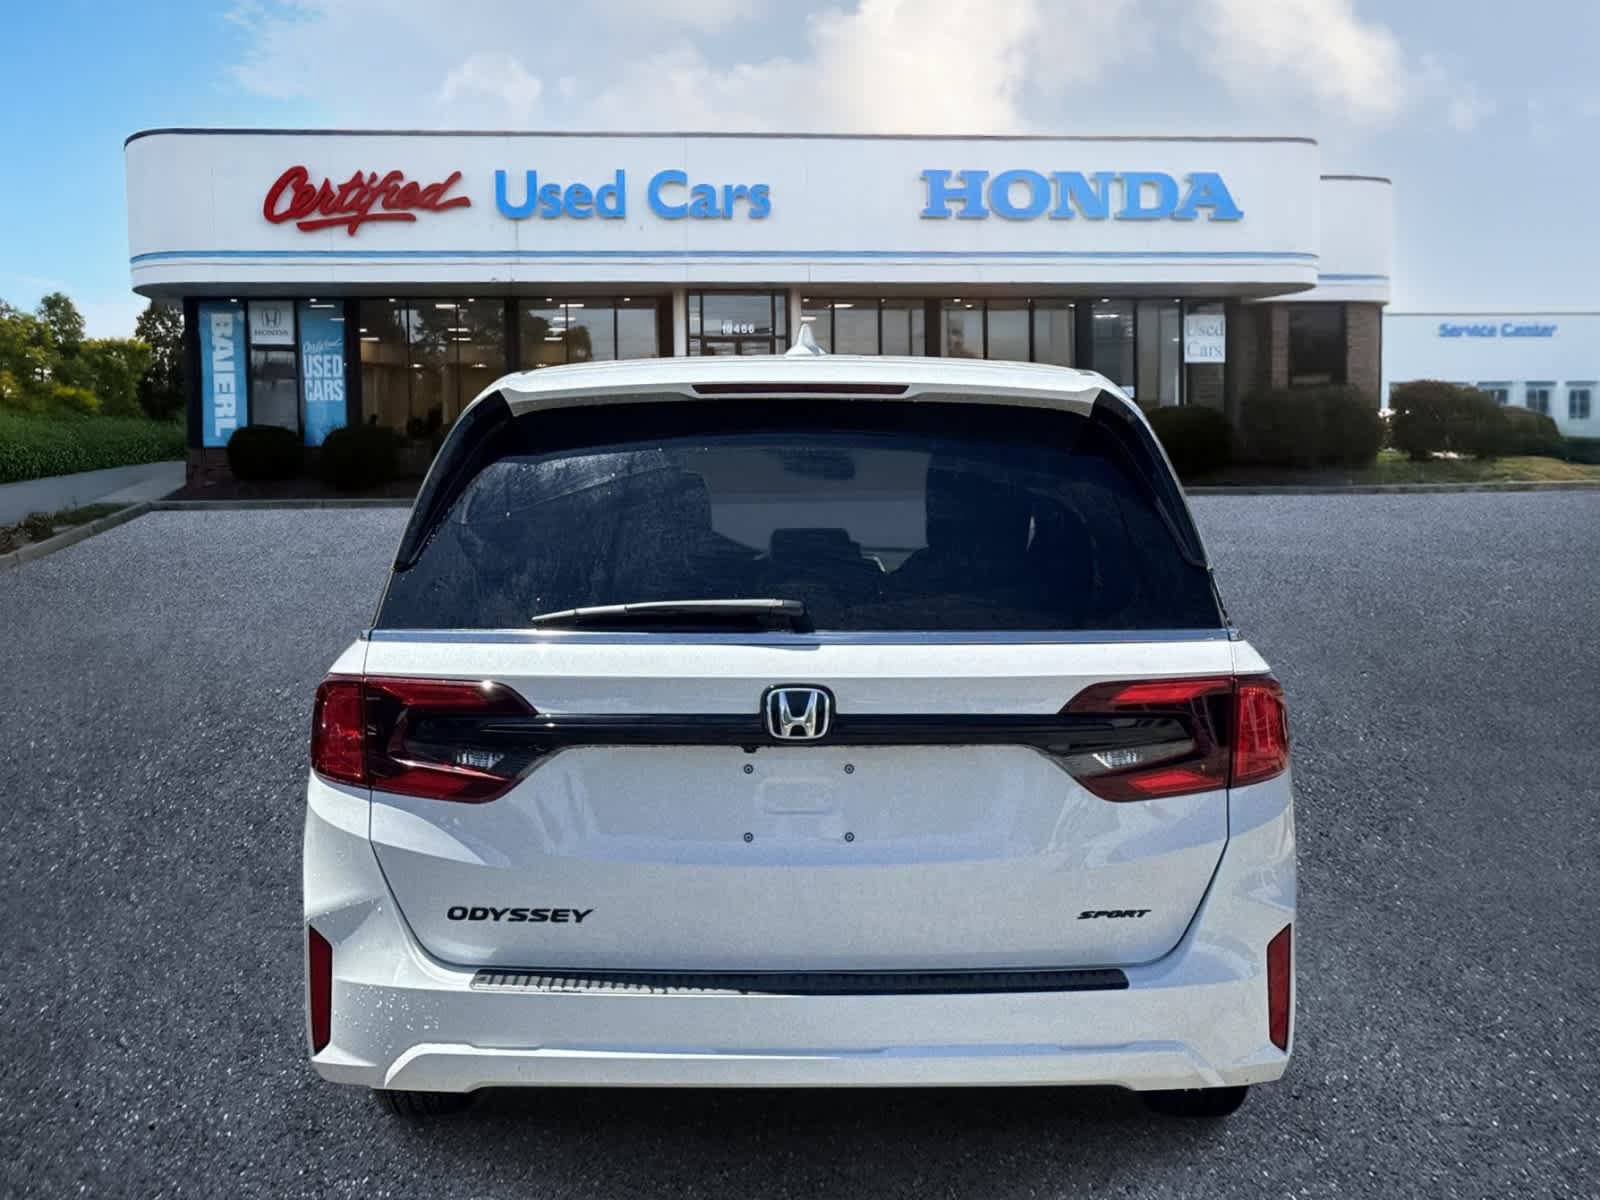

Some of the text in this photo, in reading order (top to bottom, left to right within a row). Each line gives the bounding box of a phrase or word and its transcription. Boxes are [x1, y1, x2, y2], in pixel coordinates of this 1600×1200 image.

[264, 166, 772, 235] Certified Used Cars
[919, 169, 1245, 222] HONDA
[254, 329, 289, 337] HONDA
[1186, 318, 1224, 337] Used
[1439, 322, 1558, 338] Service Center
[1186, 340, 1224, 358] Cars
[211, 312, 237, 437] BAIERL
[303, 354, 343, 378] USED
[304, 379, 344, 401] CARS
[446, 906, 594, 923] ODYSSEY
[1076, 909, 1153, 920] SPORT
